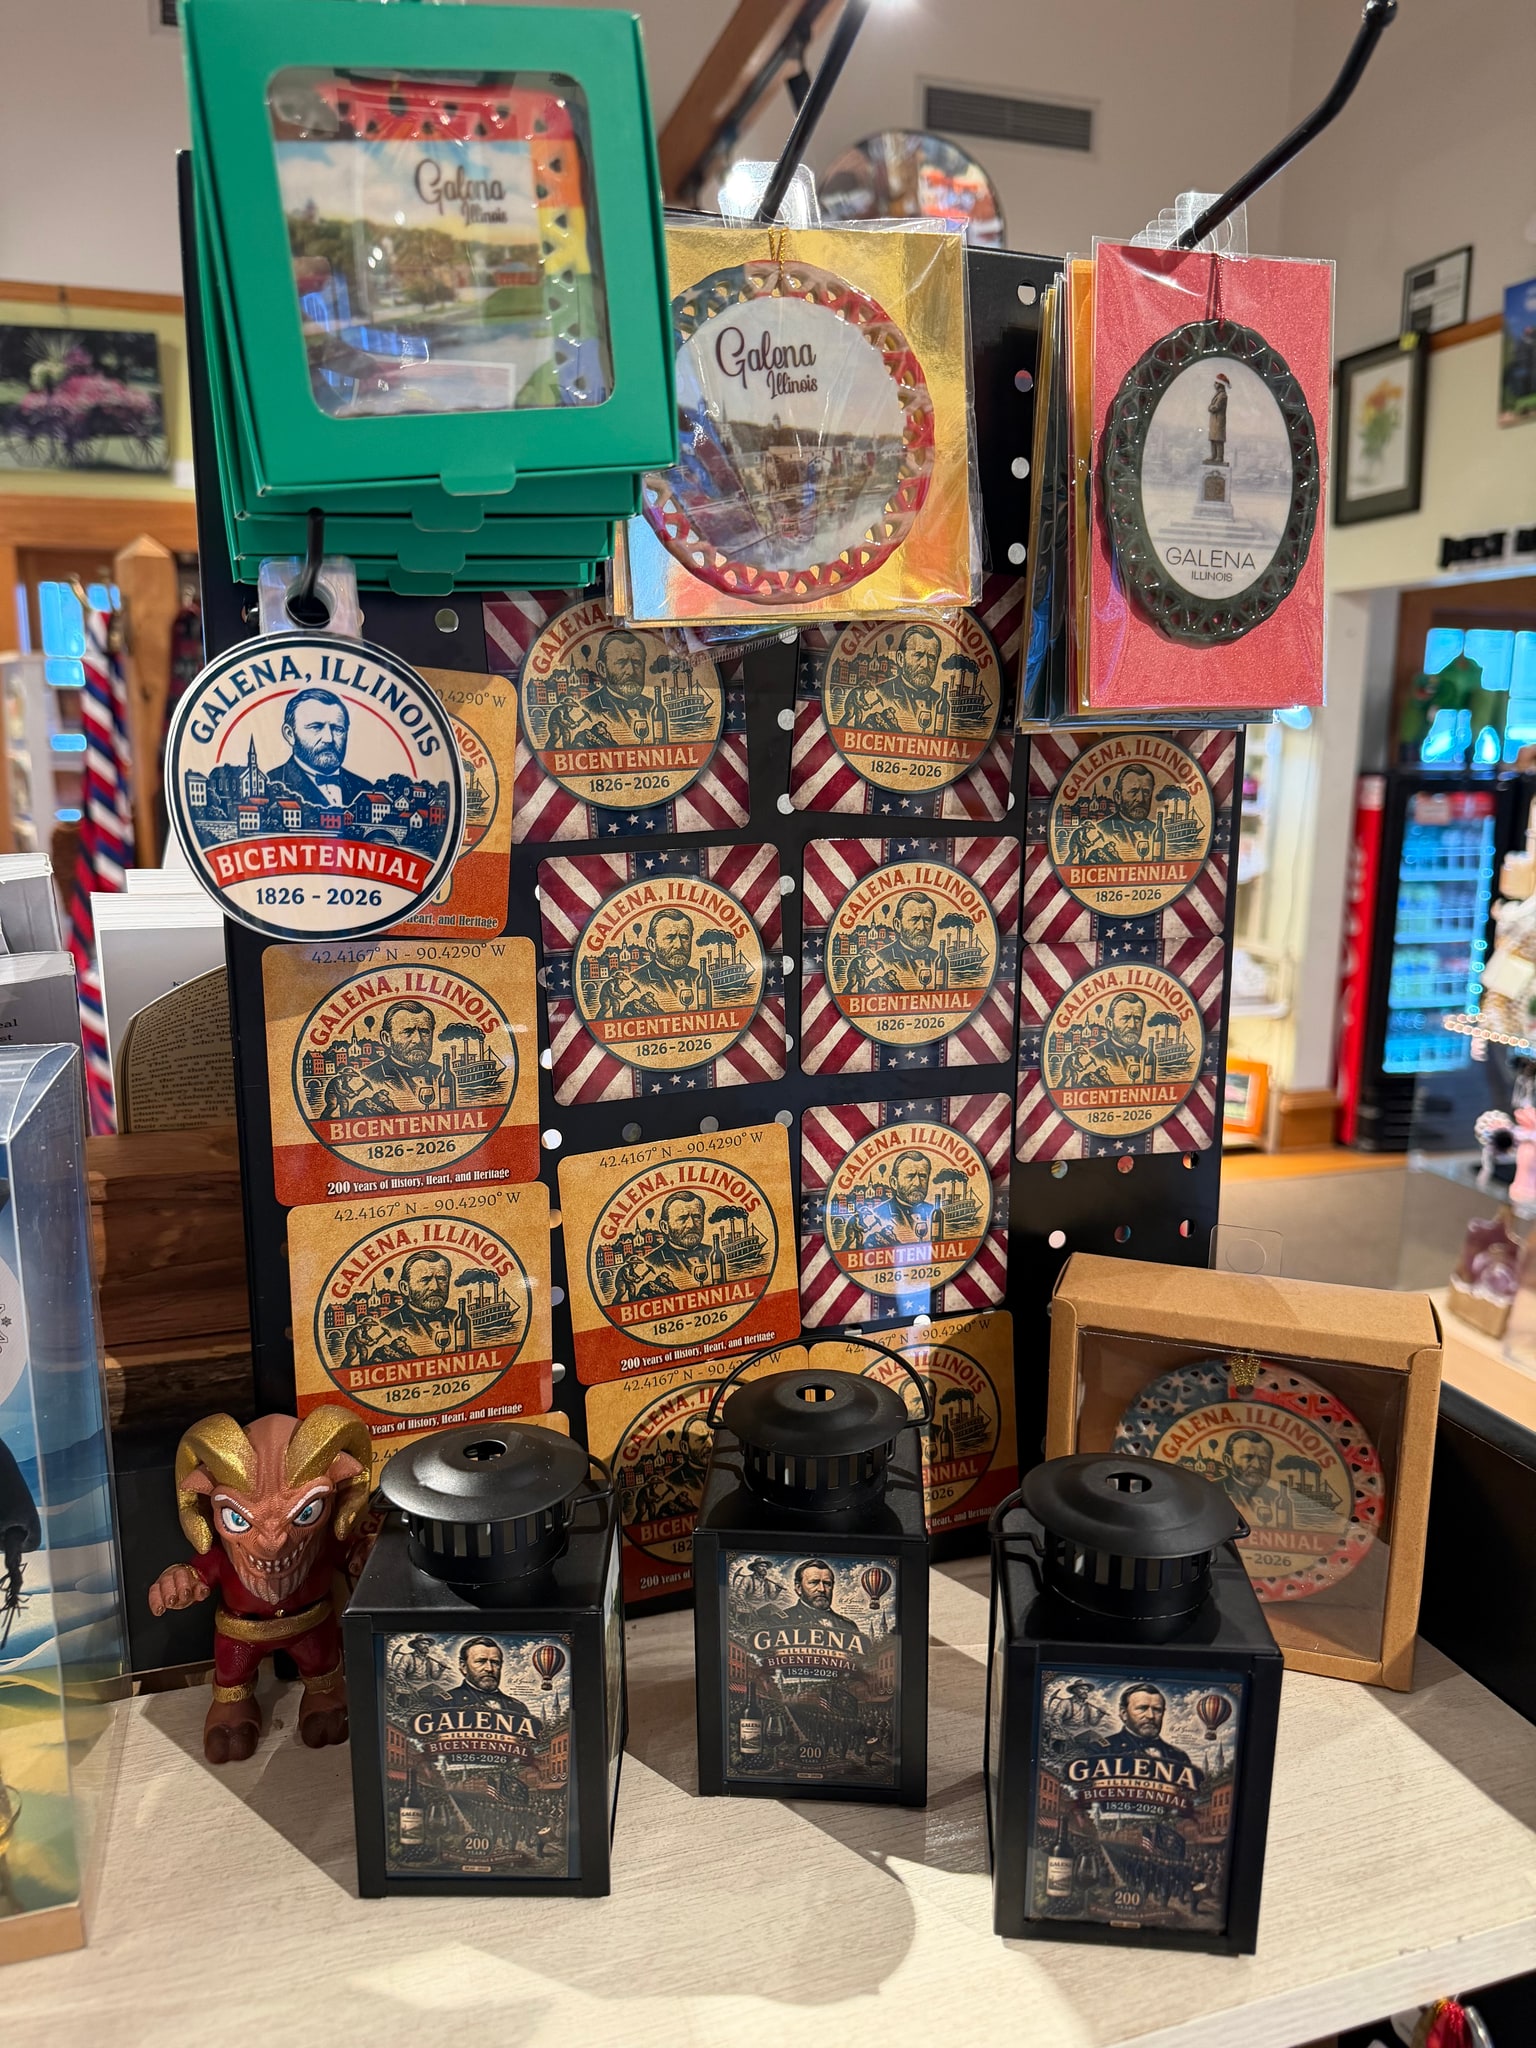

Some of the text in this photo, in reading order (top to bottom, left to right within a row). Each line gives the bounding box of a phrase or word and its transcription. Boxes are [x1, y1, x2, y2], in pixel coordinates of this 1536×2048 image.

[414, 158, 506, 216] Galena
[461, 202, 509, 226] Illinois
[715, 326, 817, 390] Galena
[766, 370, 818, 400] Illinois
[1166, 547, 1256, 570] GALENA
[1191, 570, 1233, 582] ILLINOIS
[190, 655, 441, 757] GALENA, ILLINOIS
[435, 688, 506, 708] 0.4290° W
[451, 721, 488, 769] NOIS
[843, 731, 972, 759] BICENTENNIAL
[554, 747, 699, 771] BICENTENNIAL
[870, 760, 943, 778] 1826-2026
[1063, 739, 1204, 801] GALENA, ILLINOIS
[589, 775, 671, 792] 1826-2026
[216, 845, 421, 886] BICENTENNIAL
[1070, 864, 1187, 884] BICENTENNIAL
[256, 887, 305, 905] 1826
[326, 888, 383, 907] 2026
[839, 867, 988, 930] GALENA, ILLINOIS
[1095, 889, 1162, 902] 1826-2026
[438, 915, 455, 925] and
[459, 915, 498, 928] Heritage
[586, 882, 750, 951] GALENA, ILLINOIS
[311, 947, 381, 964] 42.4167°
[386, 948, 398, 961] N
[416, 943, 487, 961] 90.4290°
[490, 944, 506, 957] W
[309, 976, 399, 1046] GALENA,
[405, 973, 501, 1035] ILLINOIS
[849, 993, 972, 1013] BICENTENNIAL
[1056, 969, 1194, 1028] GALENA, ILLINOIS
[603, 1011, 740, 1040] BICENTENNIAL
[876, 1017, 945, 1032] 1826-2026
[635, 1038, 712, 1057] 1826-2026
[1062, 1086, 1178, 1107] BICENTENNIAL
[329, 1112, 488, 1141] BICENTENNIAL
[1087, 1109, 1152, 1123] 1826-2026
[367, 1140, 456, 1160] 1826-2026
[599, 1147, 658, 1169] 42.4167°
[661, 1146, 672, 1159] N
[687, 1132, 748, 1153] 90.4290°
[750, 1131, 764, 1143] W
[837, 1128, 981, 1189] GALENA, ILLINOIS
[327, 1180, 351, 1196] 200
[353, 1180, 378, 1192] Years
[379, 1179, 389, 1190] of
[391, 1176, 424, 1189] History,
[454, 1171, 471, 1183] and
[473, 1167, 510, 1181] Heritage
[334, 1202, 400, 1222] 42.4167°
[405, 1202, 418, 1215] N
[434, 1191, 503, 1213] 90.4290°
[506, 1191, 521, 1204] W
[600, 1166, 762, 1240] GALENA, ILLINOIS
[331, 1224, 515, 1299] GALENA, ILLINOIS
[847, 1242, 967, 1268] BICENTENNIAL
[874, 1267, 941, 1284] 1826-2026
[620, 1281, 755, 1323] BICENTENNIAL
[653, 1310, 729, 1336] 1826-2026
[900, 1334, 908, 1344] N
[979, 1319, 991, 1329] W
[620, 1356, 641, 1372] 200
[642, 1354, 663, 1367] Years
[664, 1352, 673, 1362] of
[673, 1347, 702, 1360] History,
[728, 1338, 743, 1350] and
[744, 1330, 776, 1346] Heritage
[349, 1350, 502, 1388] BICENTENNIAL
[623, 1369, 679, 1392] 42.4167°
[683, 1369, 693, 1381] N
[769, 1352, 782, 1364] W
[914, 1350, 986, 1394] ILLINOIS
[385, 1379, 471, 1403] 1826-2026
[371, 1423, 396, 1435] Years
[397, 1419, 406, 1431] of
[407, 1416, 440, 1430] History,
[469, 1409, 485, 1421] and
[487, 1404, 523, 1418] Heritage
[622, 1393, 695, 1461] GALENA,
[1161, 1407, 1338, 1470] GALENA, ILLINOIS
[640, 1575, 659, 1589] 200
[753, 1629, 865, 1655] GALENA
[787, 1647, 836, 1656] ILLINOIS
[767, 1655, 858, 1671] BICENTENNIAL
[787, 1668, 838, 1678] 1826-2026
[413, 1711, 537, 1740] GALENA
[451, 1732, 506, 1741] ILLINOIS
[430, 1739, 528, 1757] BICENTENNIAL
[451, 1753, 507, 1764] 1826-2026
[799, 1746, 822, 1758] 200
[1068, 1757, 1197, 1791] GALENA
[1105, 1779, 1164, 1789] ILLINOIS
[1083, 1787, 1187, 1808] BICENTENNIAL
[1105, 1801, 1164, 1815] 1826-2026
[465, 1837, 489, 1850] 200
[1114, 1891, 1140, 1905] 200
